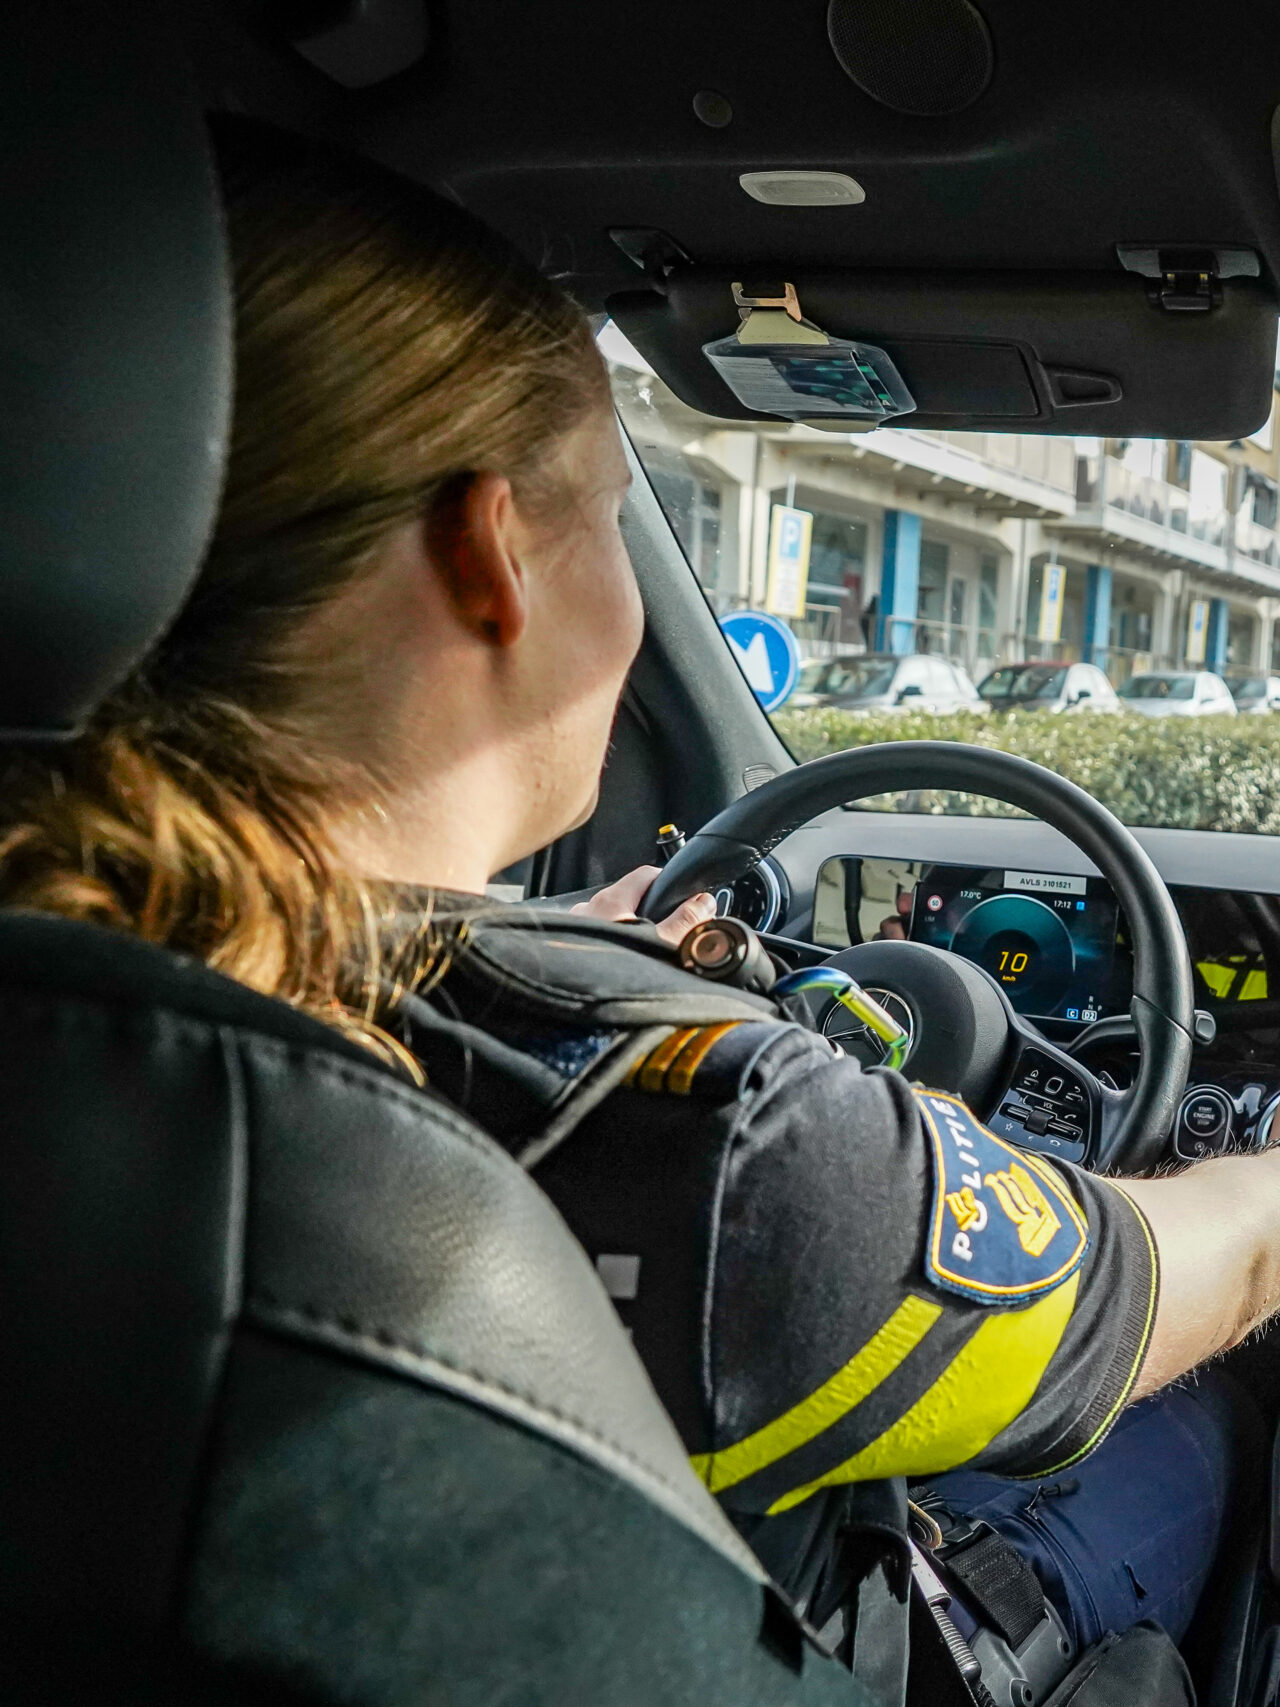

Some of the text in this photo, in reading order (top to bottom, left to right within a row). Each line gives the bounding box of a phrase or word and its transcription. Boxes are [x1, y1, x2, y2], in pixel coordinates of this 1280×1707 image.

[1020, 877, 1041, 887] AVLS
[999, 951, 1028, 973] 10
[930, 1098, 988, 1262] POLITIE
